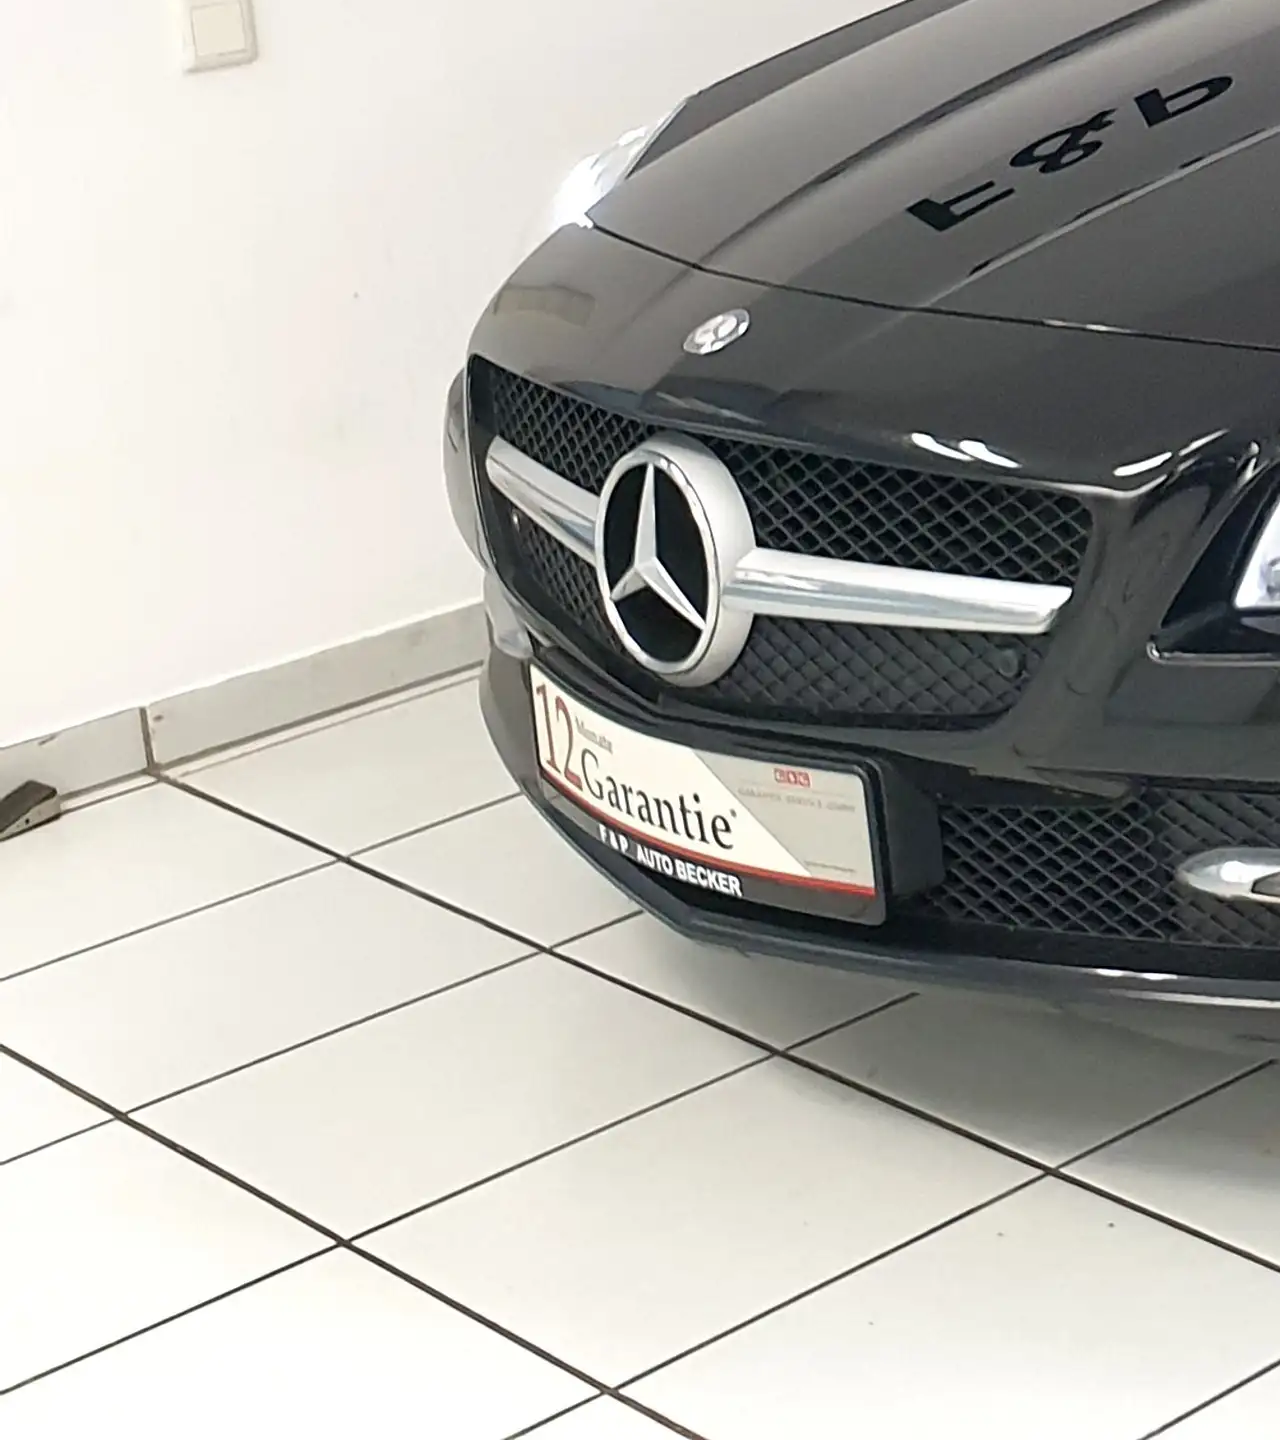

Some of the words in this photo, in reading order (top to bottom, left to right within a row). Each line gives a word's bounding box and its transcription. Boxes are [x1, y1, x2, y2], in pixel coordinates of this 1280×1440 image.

[536, 682, 583, 792] 12
[636, 843, 674, 877] AUTO
[673, 857, 743, 898] BECKER
